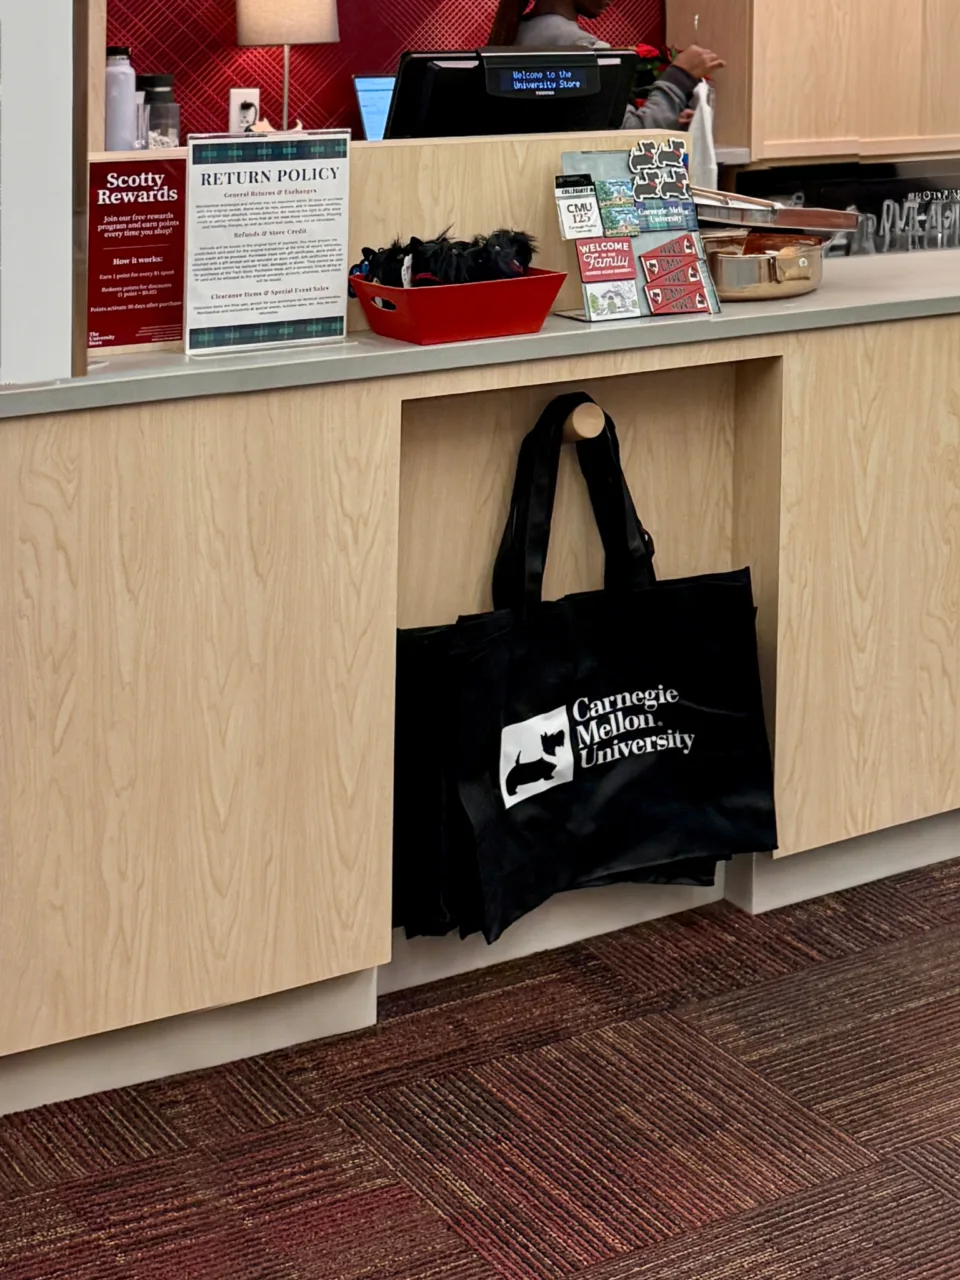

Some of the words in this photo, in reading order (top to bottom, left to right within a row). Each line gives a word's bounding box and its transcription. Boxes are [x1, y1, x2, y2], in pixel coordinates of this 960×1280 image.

[512, 70, 543, 79] Welcome
[546, 71, 556, 79] to
[559, 70, 572, 78] the
[513, 80, 556, 90] University
[559, 80, 581, 88] Store
[106, 172, 165, 190] Scotty
[200, 170, 272, 187] RETURN
[277, 166, 340, 183] POLICY
[97, 186, 178, 205] Rewards
[566, 202, 593, 214] CMU
[638, 207, 668, 215] Carnegie
[103, 215, 118, 223] Join
[132, 213, 146, 221] free
[147, 212, 174, 220] rewards
[572, 213, 591, 224] 125
[649, 214, 682, 223] University
[97, 223, 127, 232] program
[127, 221, 141, 229] and
[158, 219, 180, 228] points
[104, 231, 123, 239] every
[154, 227, 173, 235] shop!
[578, 242, 630, 253] WELCOME
[583, 252, 630, 269] Family
[572, 684, 679, 722] Carnegie
[575, 712, 656, 748] Mellon
[579, 729, 695, 768] University
